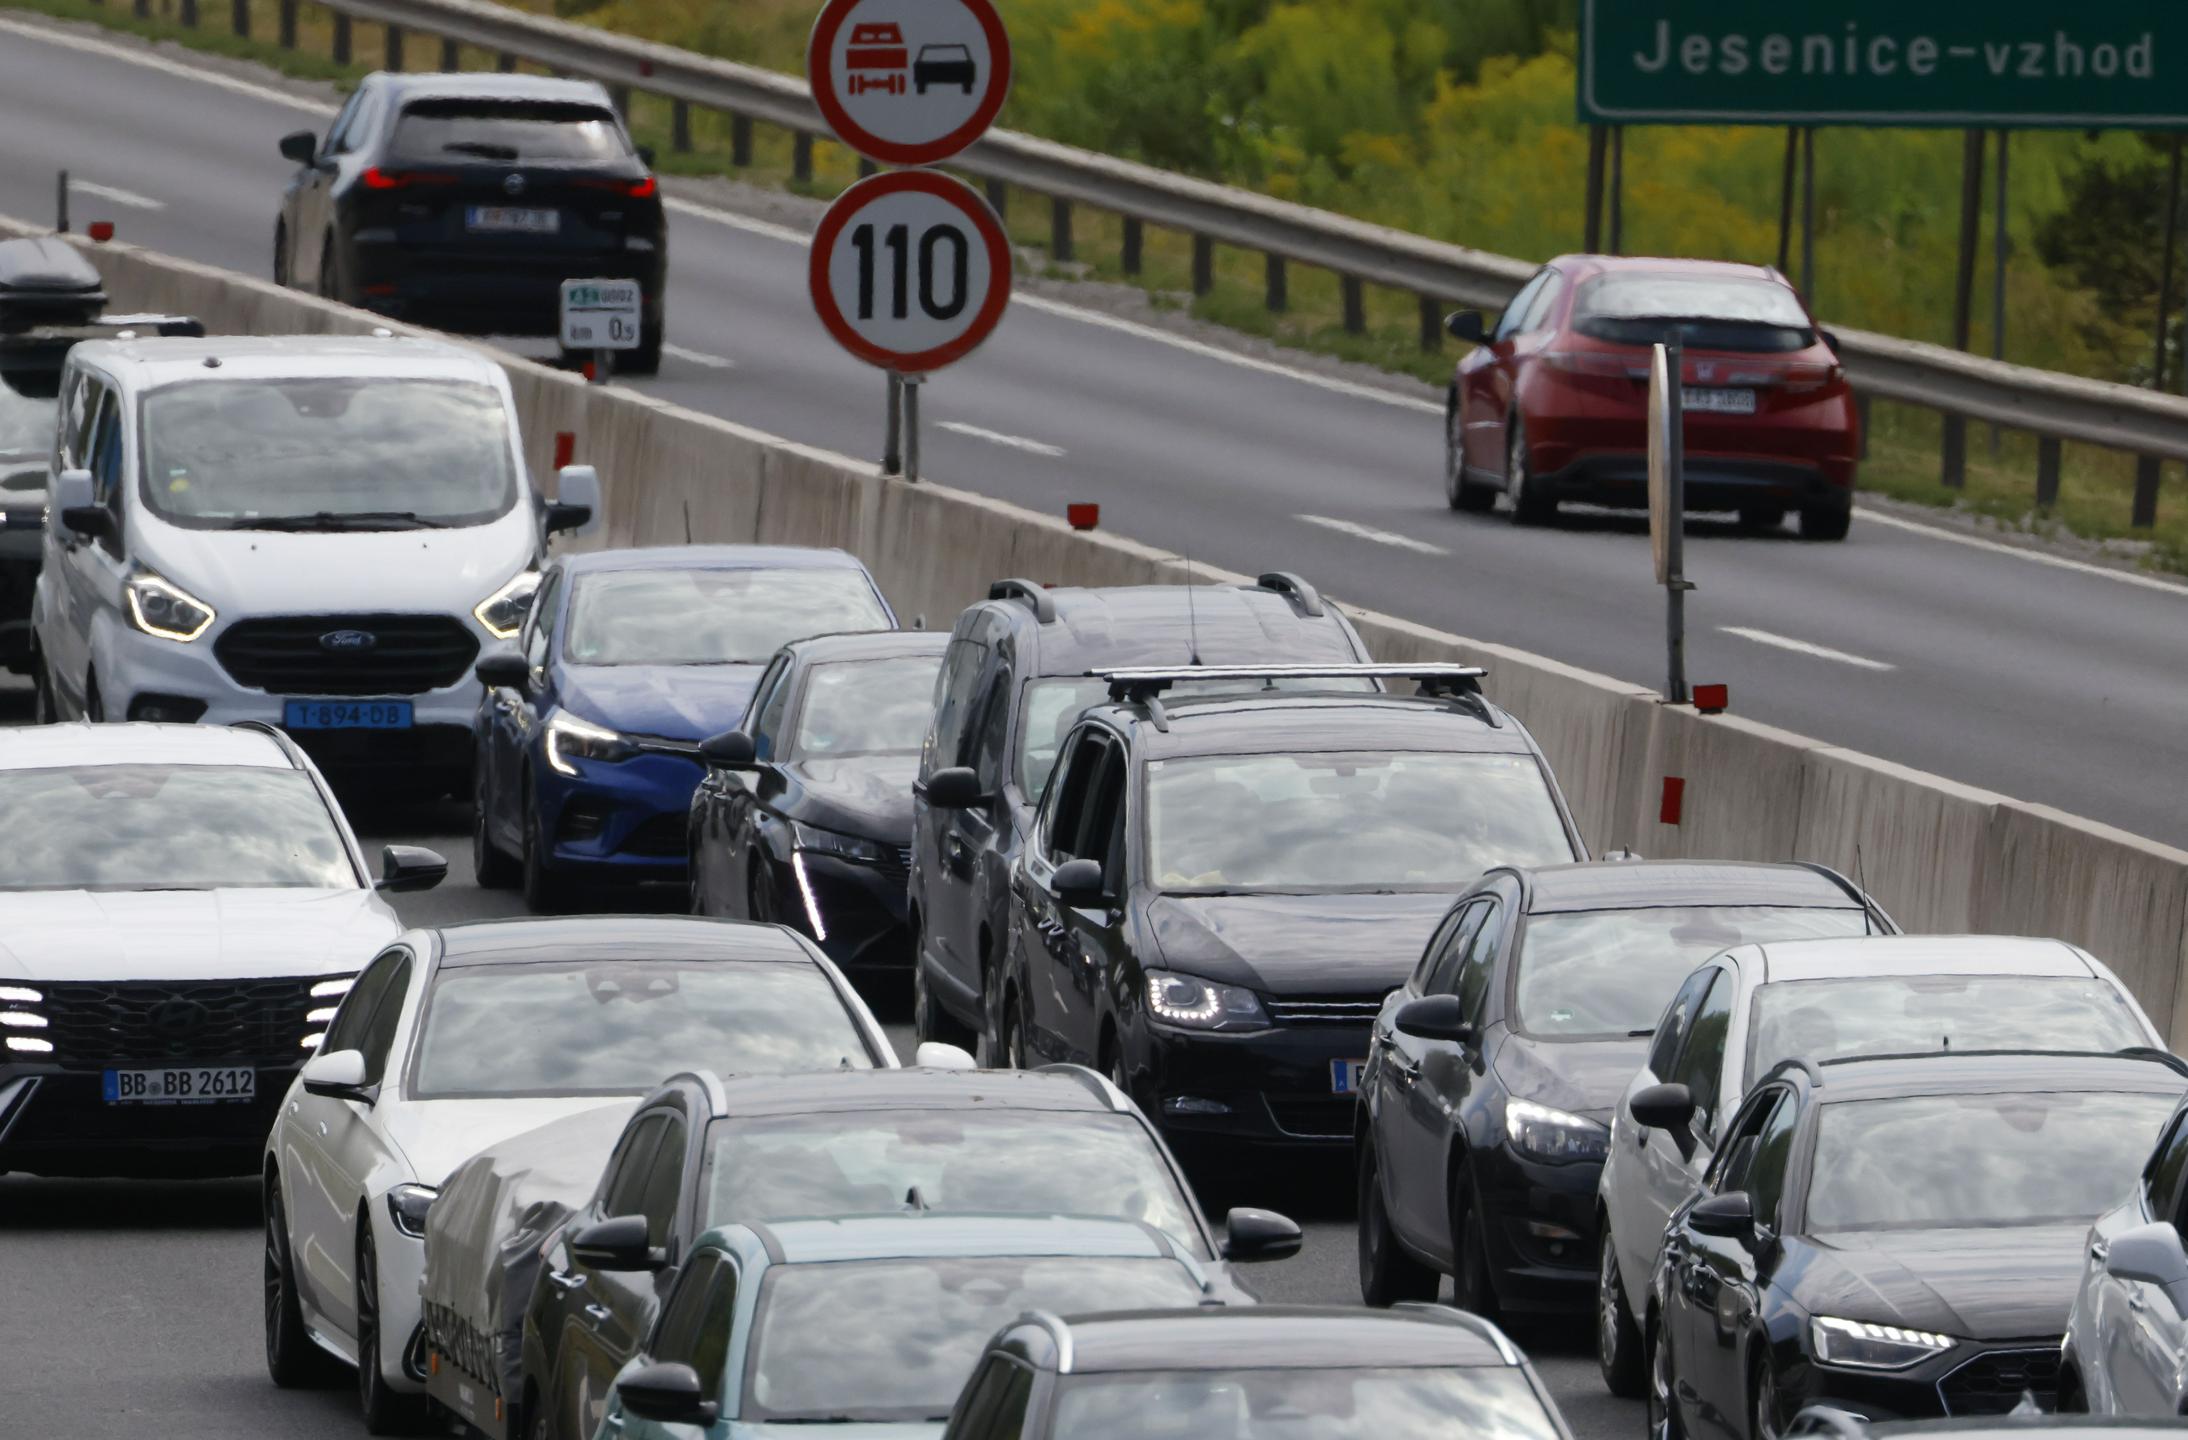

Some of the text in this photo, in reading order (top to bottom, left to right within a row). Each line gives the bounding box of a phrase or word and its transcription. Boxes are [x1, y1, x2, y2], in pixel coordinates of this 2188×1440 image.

[1633, 19, 2154, 78] Jesenice-vzhod
[851, 223, 968, 320] 110
[331, 631, 361, 646] Ford
[299, 705, 400, 725] T-894-DB
[120, 1073, 146, 1096] BB
[164, 1071, 191, 1095] BB
[199, 1070, 253, 1095] 2612
